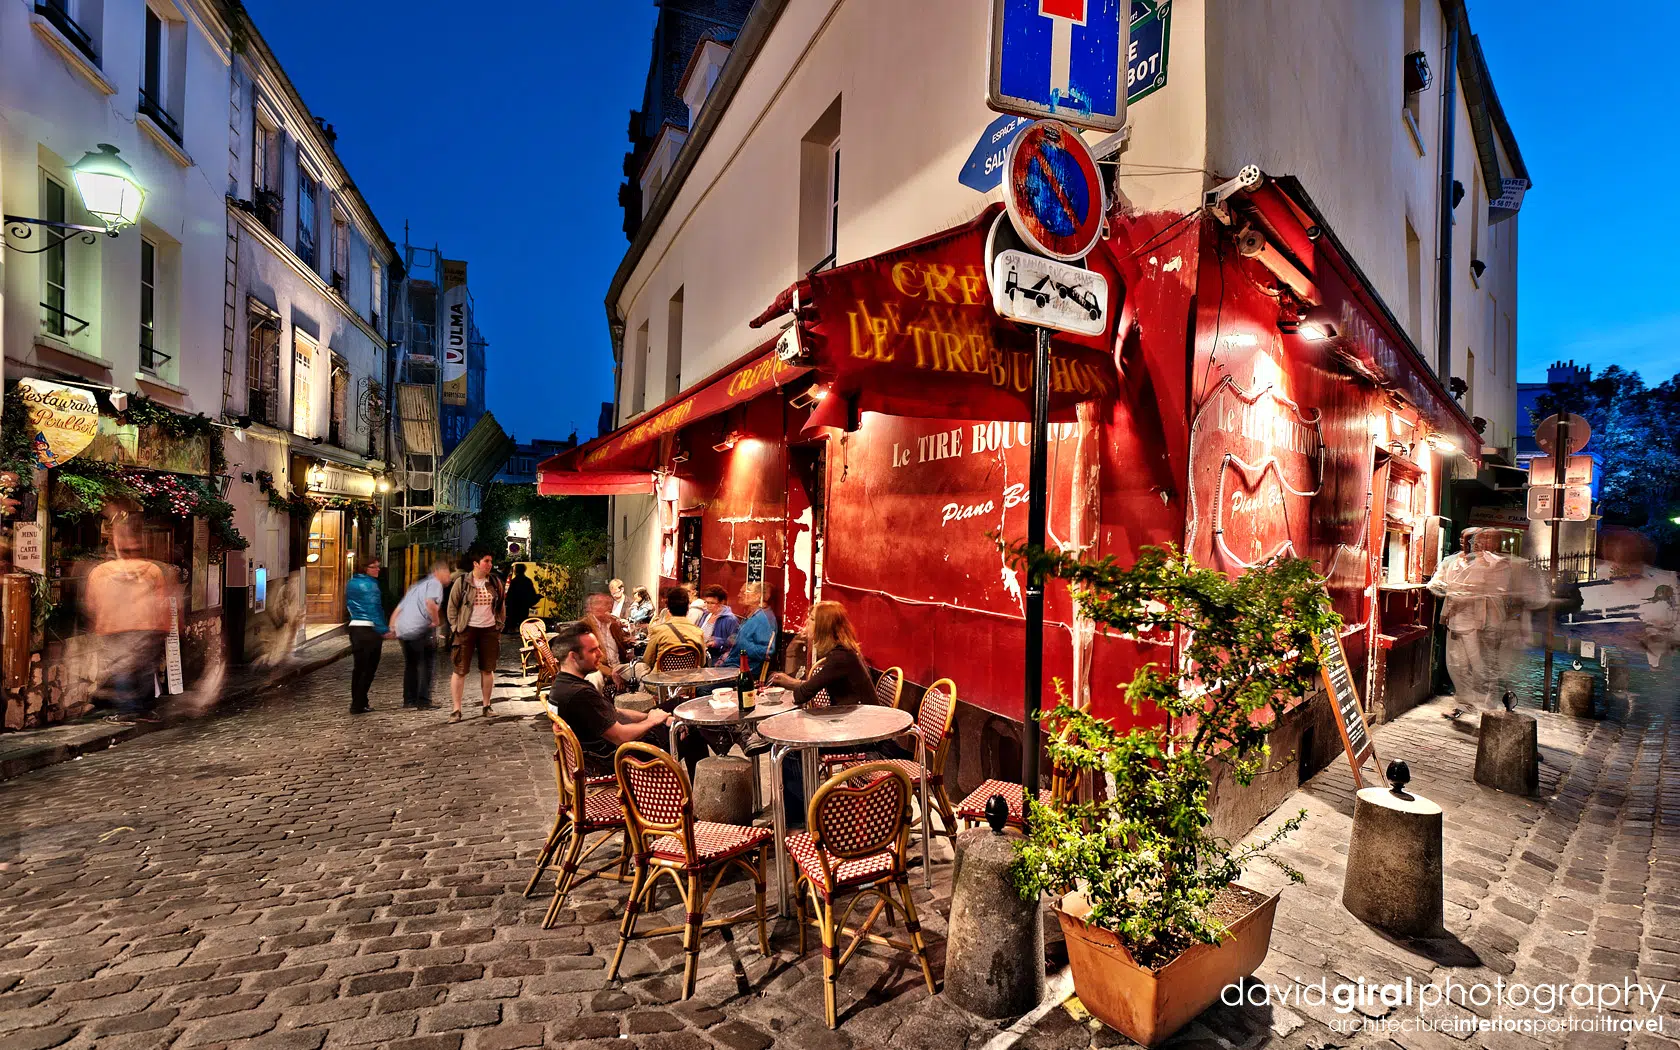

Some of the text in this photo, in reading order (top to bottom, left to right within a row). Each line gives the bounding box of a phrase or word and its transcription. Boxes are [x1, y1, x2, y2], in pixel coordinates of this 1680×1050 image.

[992, 120, 1016, 144] ESPACE
[450, 303, 464, 346] ULMA
[847, 308, 895, 362] LE
[906, 324, 989, 374] TIRE
[20, 384, 98, 415] Restaurant
[1218, 393, 1235, 432] Le
[31, 409, 98, 436] Poulbot
[892, 442, 910, 468] Le
[917, 427, 962, 463] TIRE
[942, 499, 994, 527] Piano
